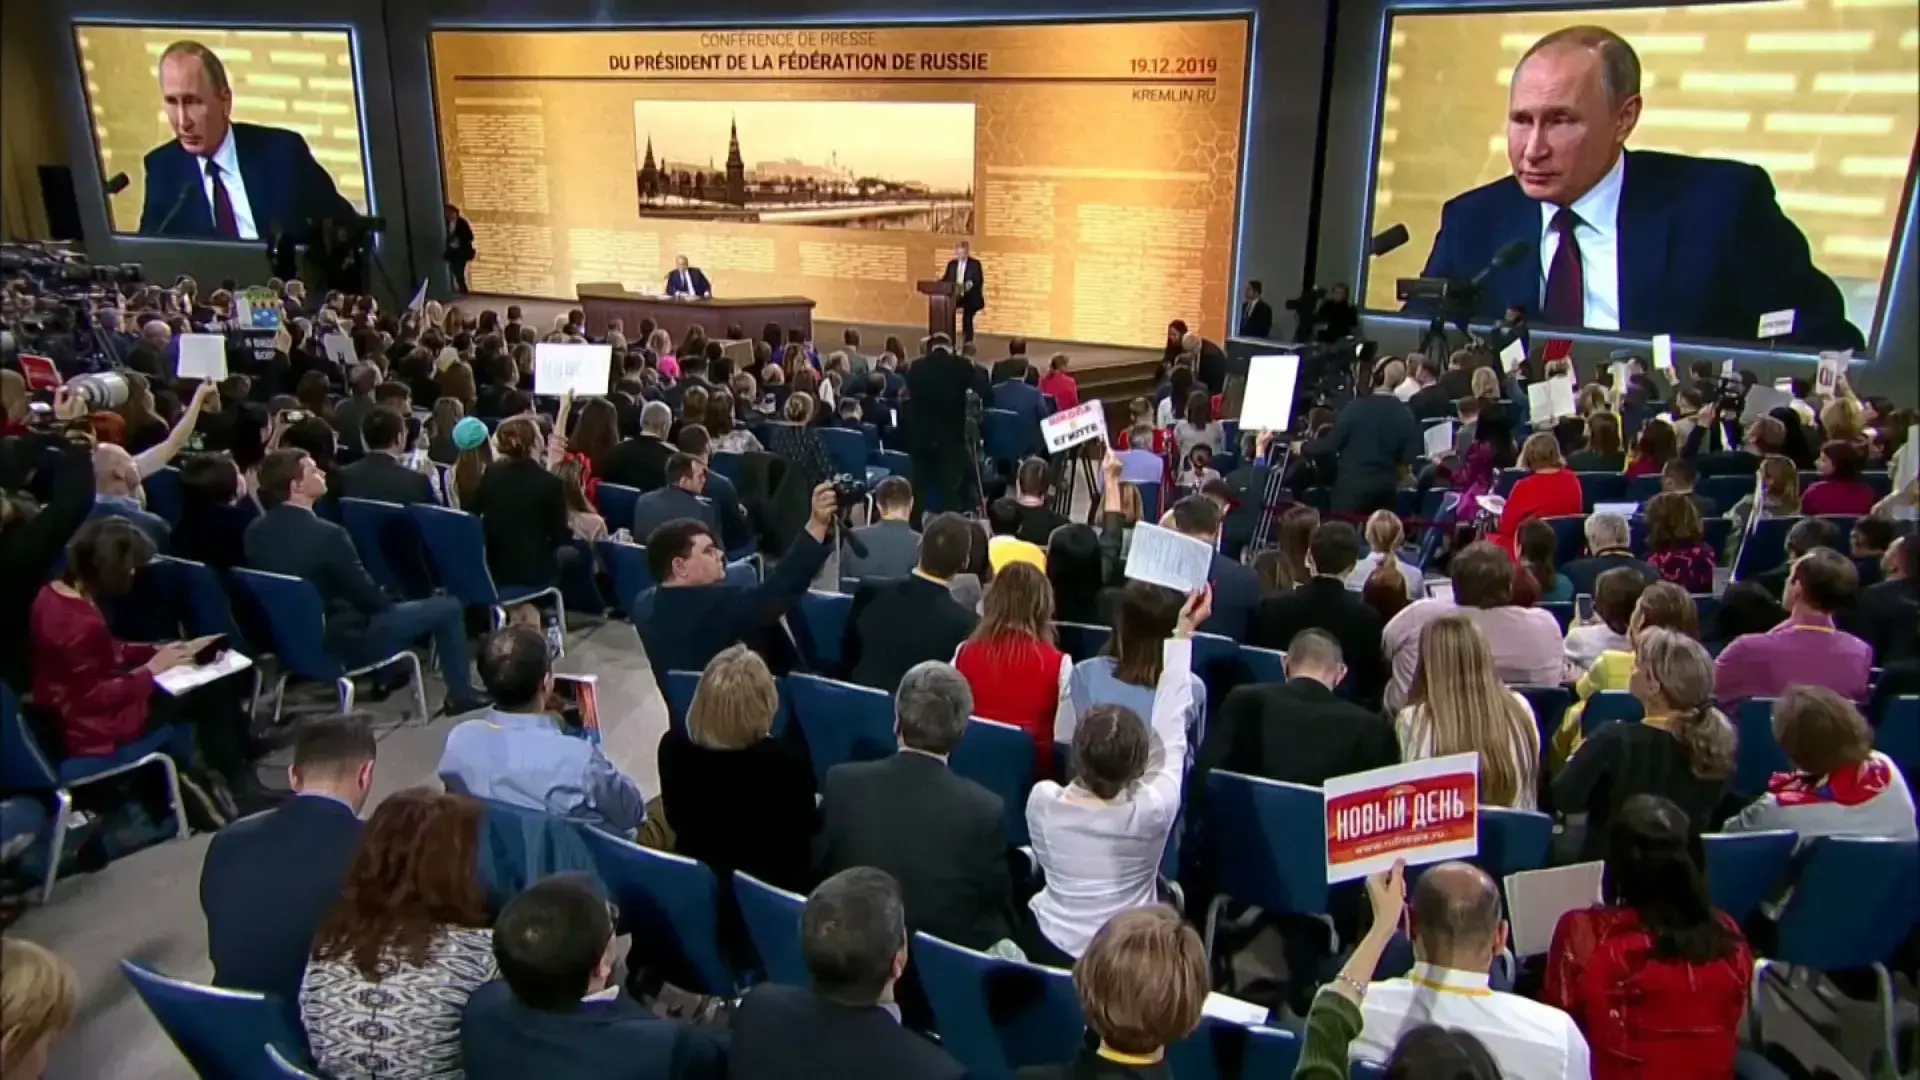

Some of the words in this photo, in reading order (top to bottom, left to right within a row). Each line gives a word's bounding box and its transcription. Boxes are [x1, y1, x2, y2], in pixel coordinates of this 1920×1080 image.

[798, 31, 817, 47] DE
[821, 31, 877, 47] PRESSE
[609, 54, 630, 71] DU
[634, 50, 722, 71] PRÉSIDENT
[727, 53, 748, 70] DE
[752, 53, 773, 70] LA
[778, 50, 887, 70] FÉDÉRATION
[892, 53, 915, 70] DE
[920, 52, 989, 70] RUSSIE
[1130, 57, 1217, 74] 19.12.2019
[1336, 795, 1405, 842] НОВЫЙ
[1412, 788, 1465, 831] ДЕНЬ
